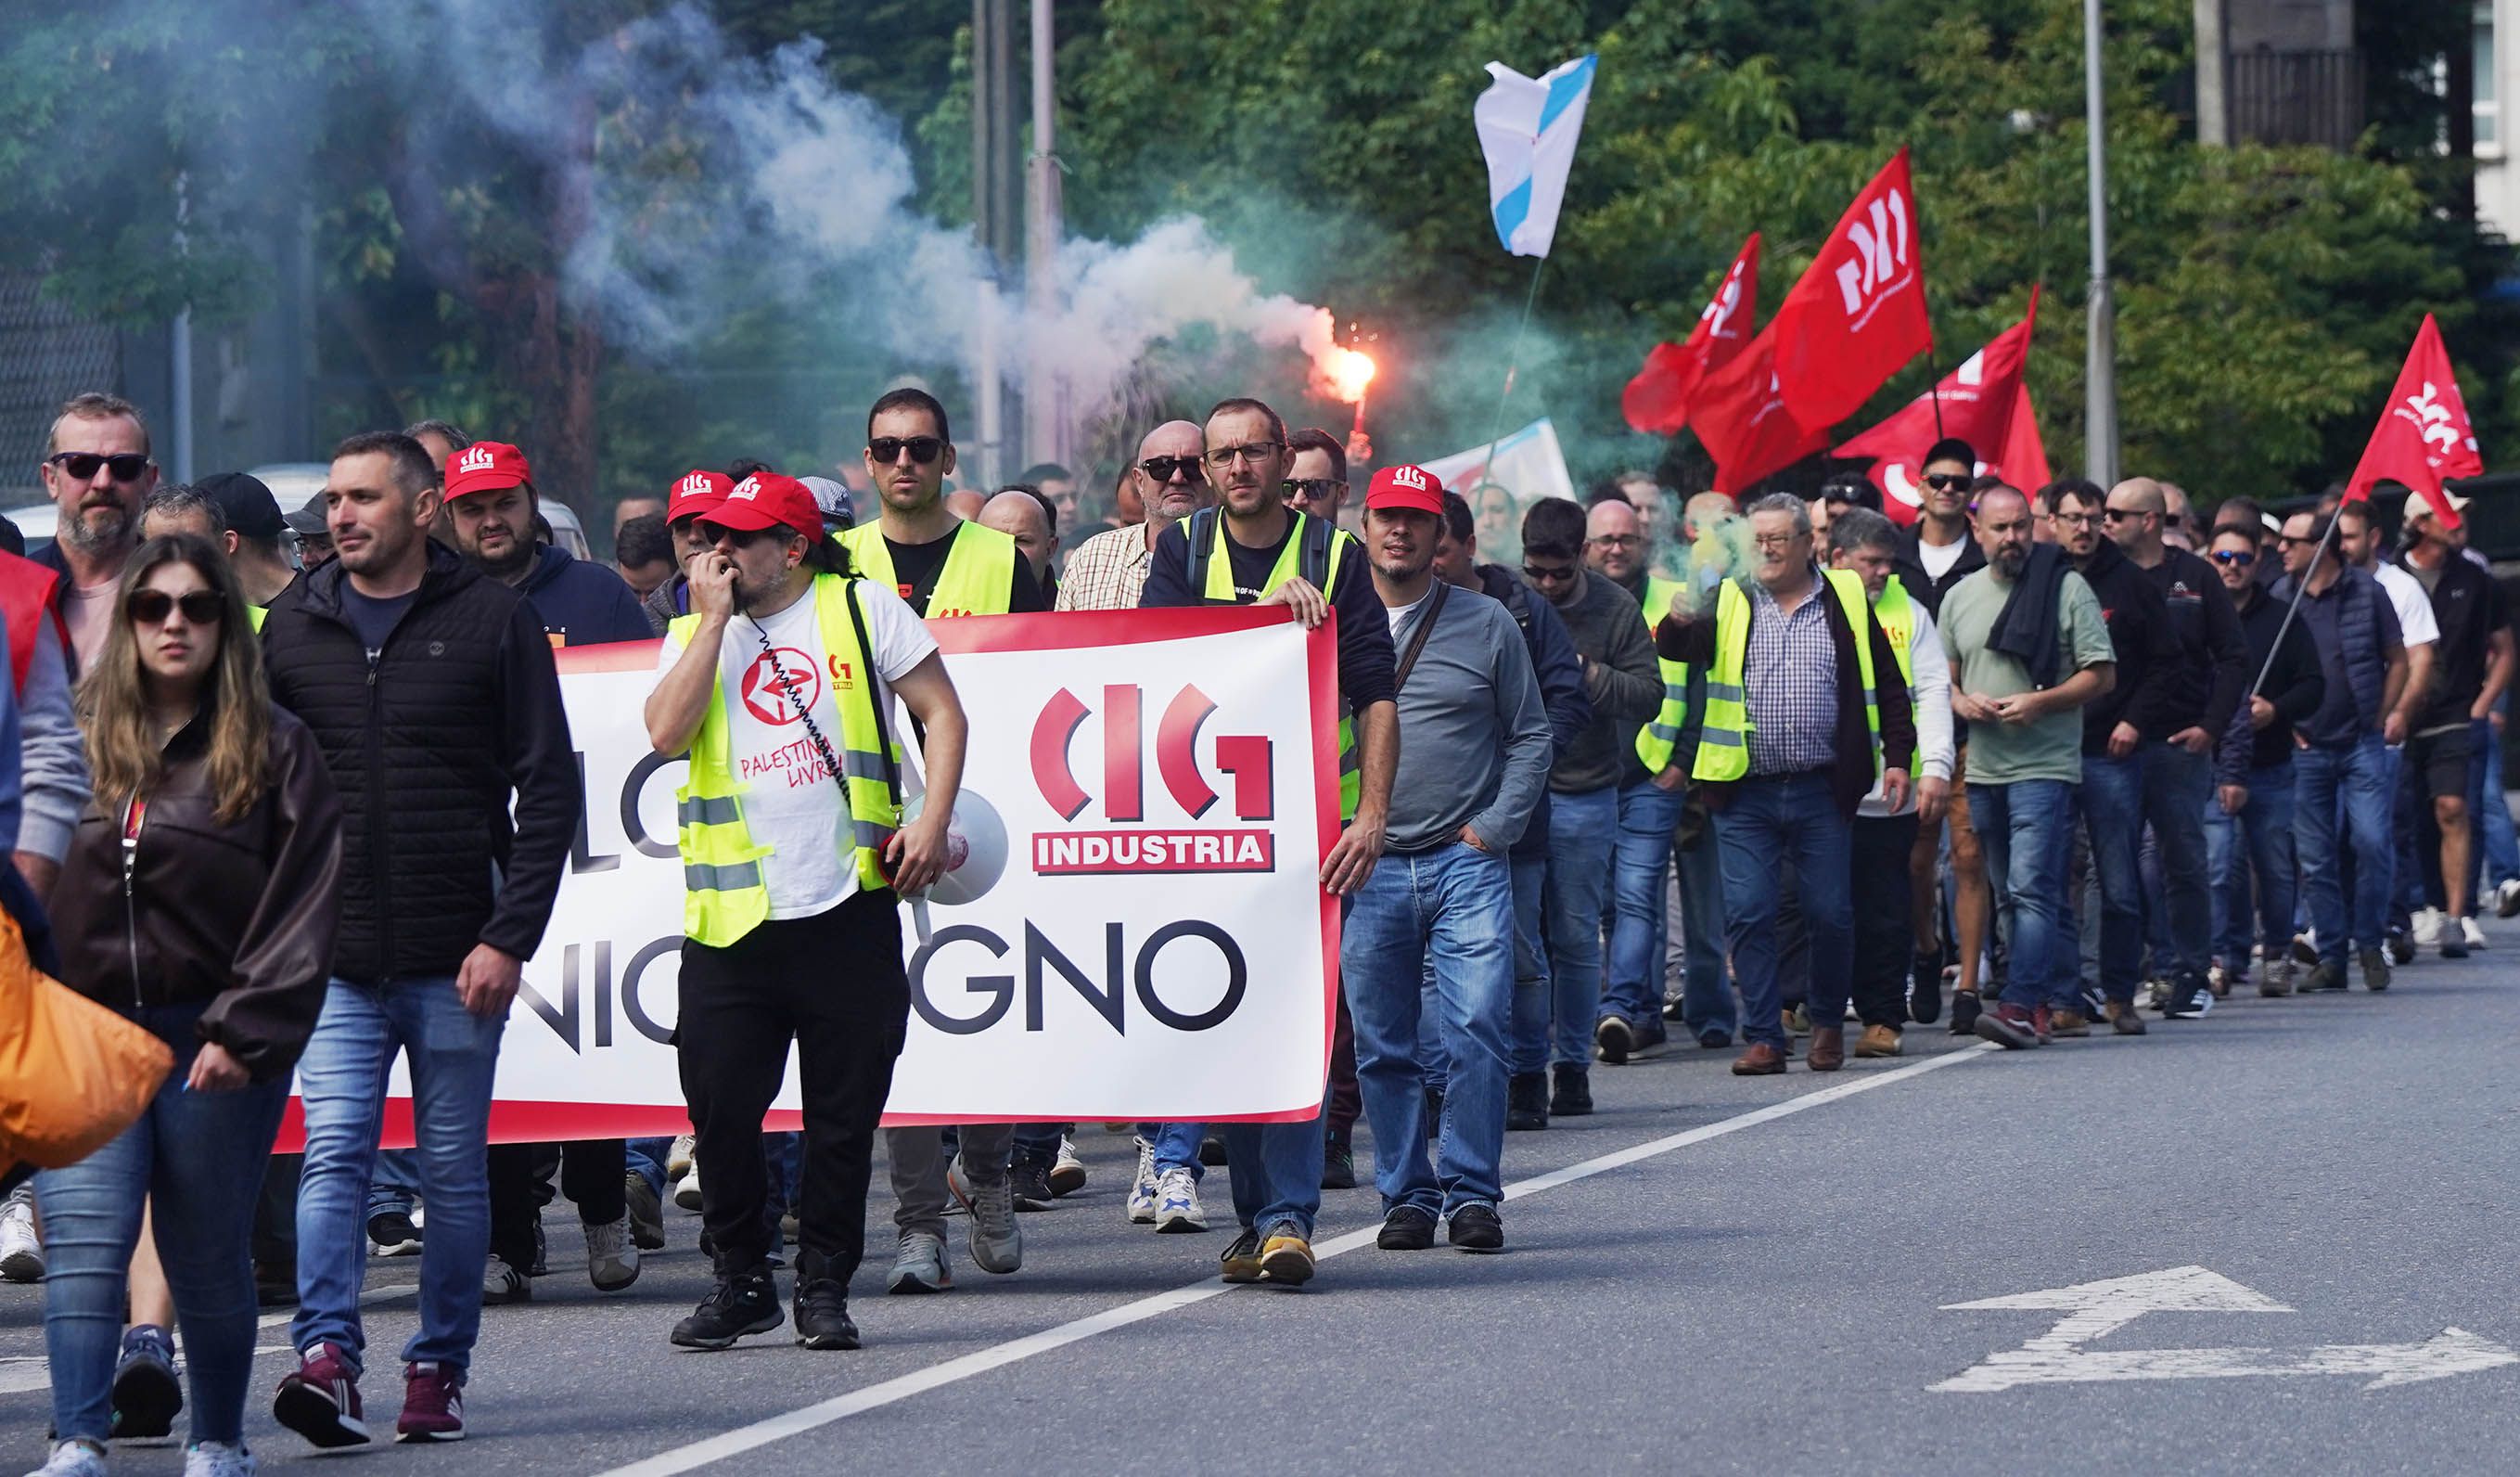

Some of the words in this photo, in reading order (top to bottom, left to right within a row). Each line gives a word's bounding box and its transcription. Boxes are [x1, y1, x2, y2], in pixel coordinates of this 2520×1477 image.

[460, 447, 493, 466] CIG
[1395, 466, 1426, 486] CIG
[1030, 683, 1274, 822] CIG
[1037, 835, 1264, 866] INDUSTRIA
